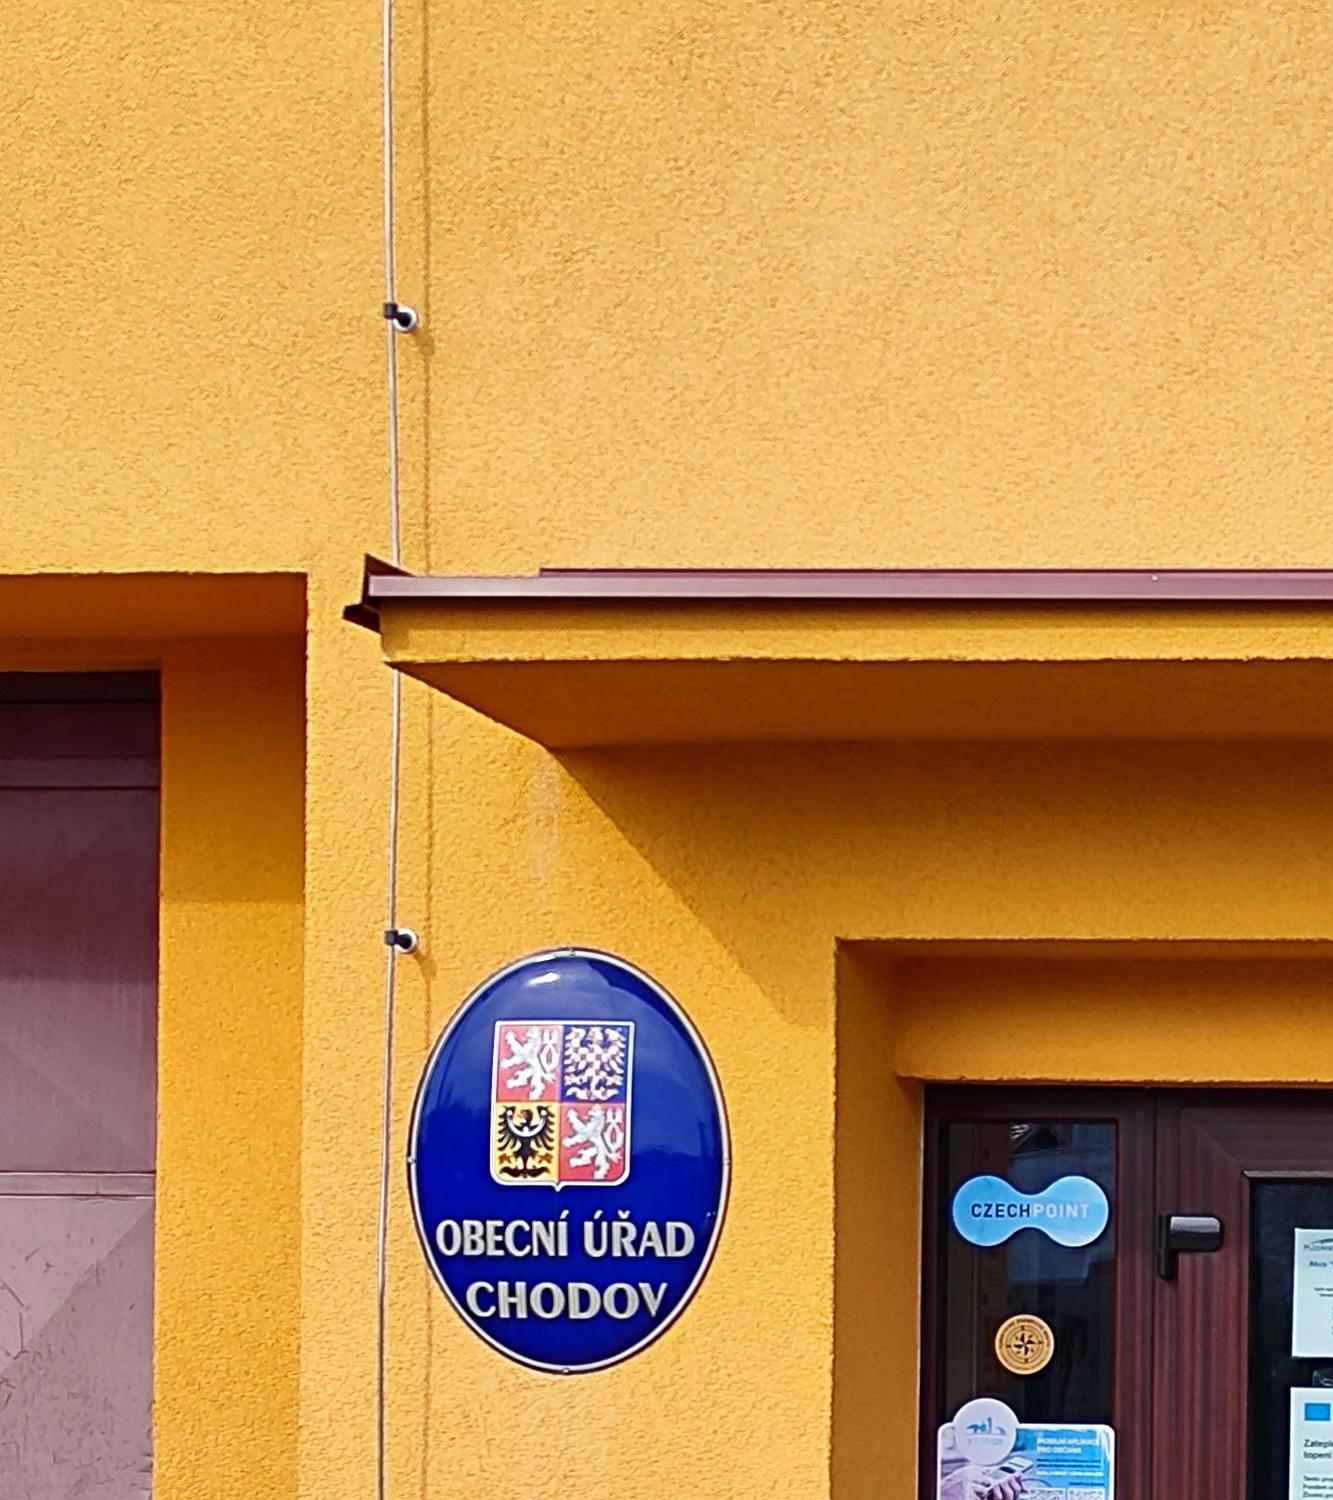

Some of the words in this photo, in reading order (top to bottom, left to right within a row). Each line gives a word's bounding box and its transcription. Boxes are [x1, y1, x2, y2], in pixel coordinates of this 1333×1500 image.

[435, 1209, 569, 1258] OBECNÍ
[583, 1209, 696, 1258] ÚŘAD
[465, 1280, 669, 1320] CHODOV
